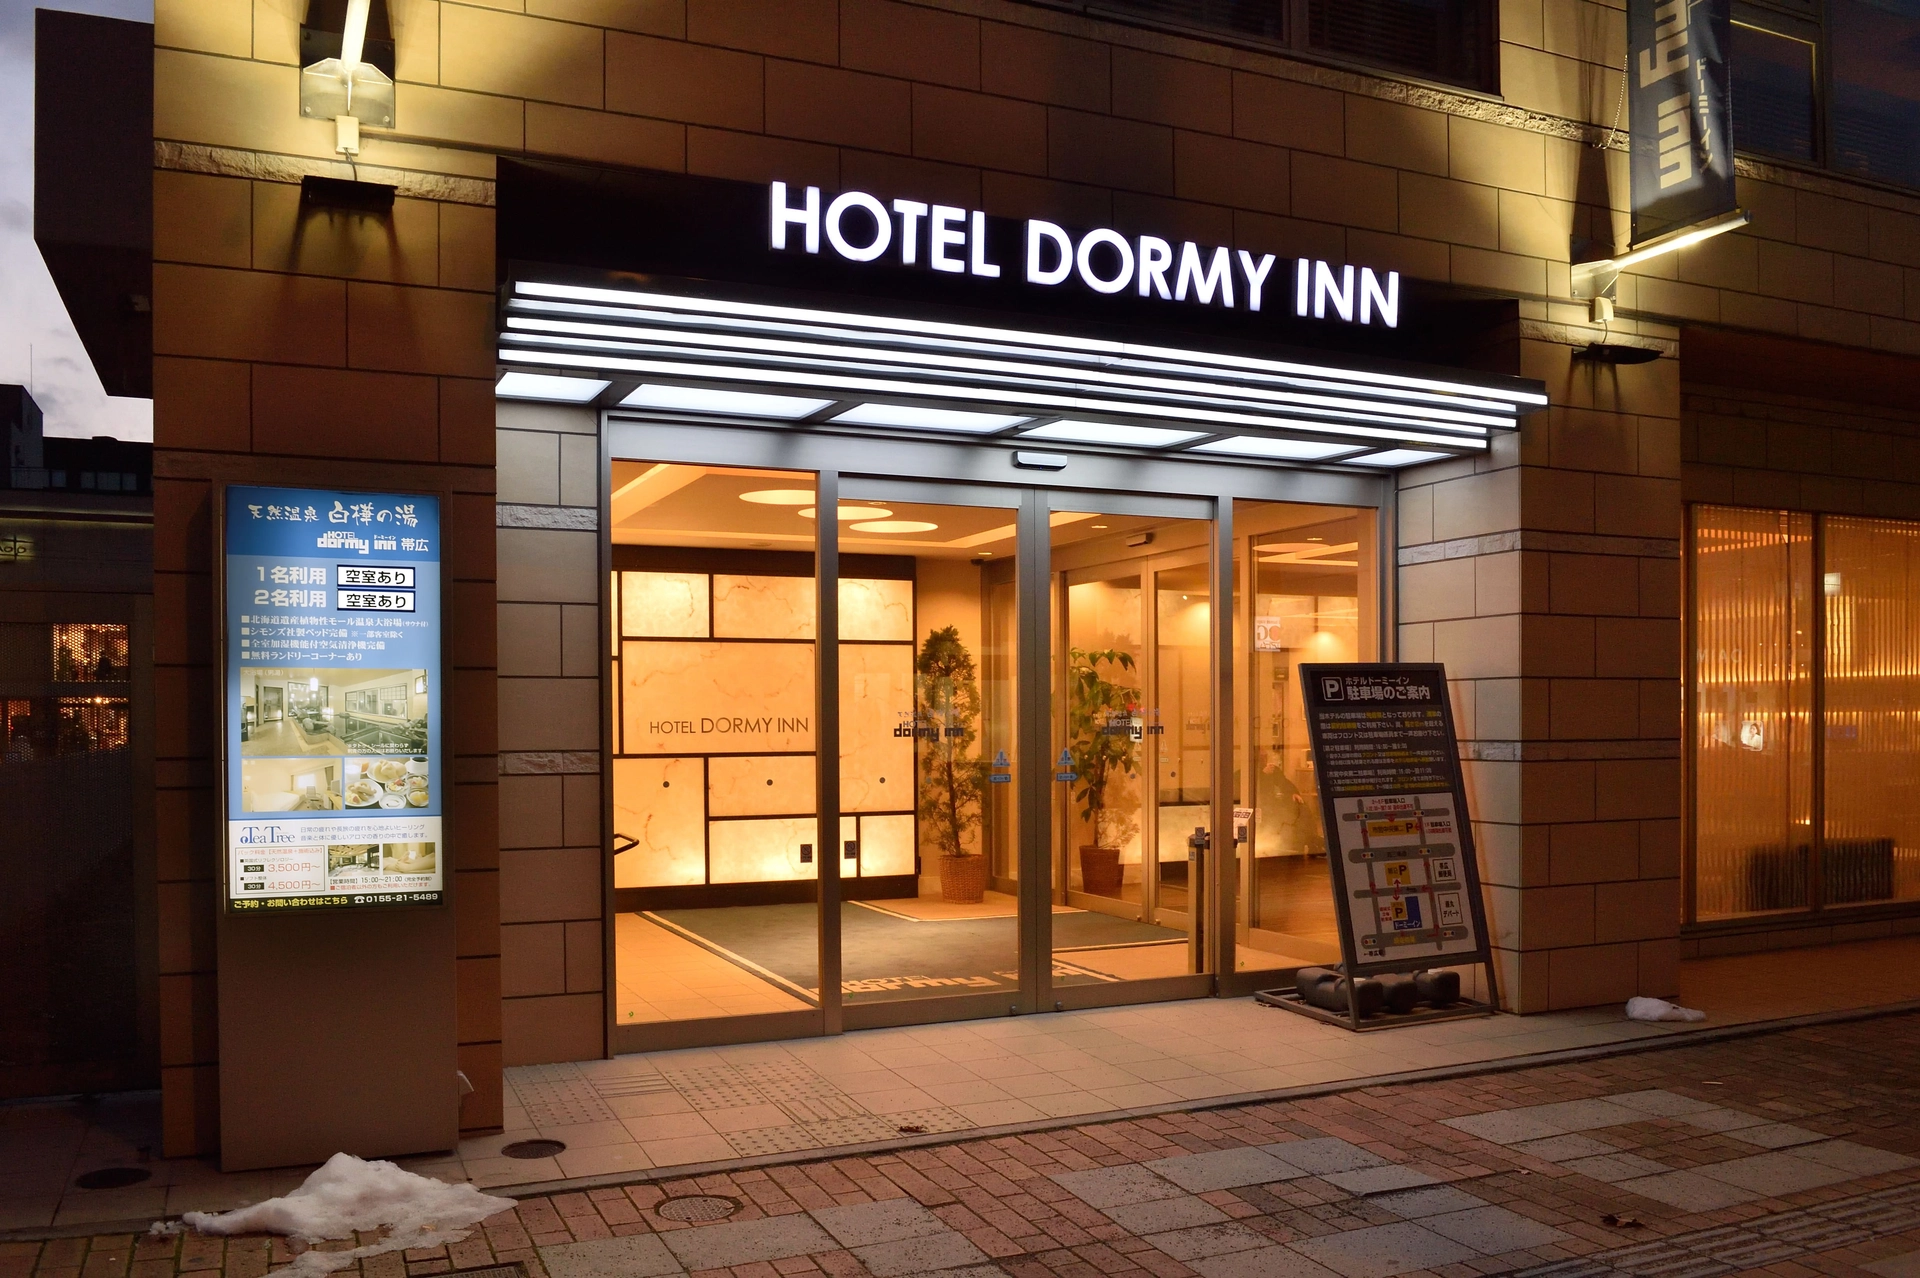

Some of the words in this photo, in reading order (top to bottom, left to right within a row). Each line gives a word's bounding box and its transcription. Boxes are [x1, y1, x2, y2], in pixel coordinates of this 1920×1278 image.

[1658, 92, 1692, 189] inn
[770, 181, 1000, 278] HOTEL
[1025, 217, 1276, 312] DORMY
[1297, 257, 1400, 328] INN
[248, 503, 320, 523] 天然温泉
[328, 500, 419, 528] 白樺の湯
[317, 533, 370, 554] dormy
[374, 539, 397, 550] inn
[401, 537, 429, 552] 帯広
[327, 530, 356, 540] HOTEL
[256, 566, 327, 585] 1名利用
[345, 569, 406, 584] 空室あり
[254, 589, 327, 608] 2名利用
[346, 593, 407, 608] 空室あり
[250, 651, 363, 662] 無料ランドリーコーナーあり
[1325, 679, 1340, 698] P
[1345, 676, 1410, 685] ホテルドーミーイン
[1347, 685, 1431, 701] 駐車場のご案内
[650, 721, 696, 734] HOTEL
[701, 717, 773, 733] DORMY
[777, 717, 808, 733] INN
[894, 723, 939, 741] dormy
[1147, 726, 1164, 735] inn
[264, 826, 295, 844] Tree
[1398, 865, 1407, 876] P
[233, 896, 348, 909] ご予約・お問い合わせはこちら
[366, 893, 438, 904] 0155-21-5489
[1394, 907, 1404, 919] P
[1394, 920, 1421, 929] ドーミーイン
